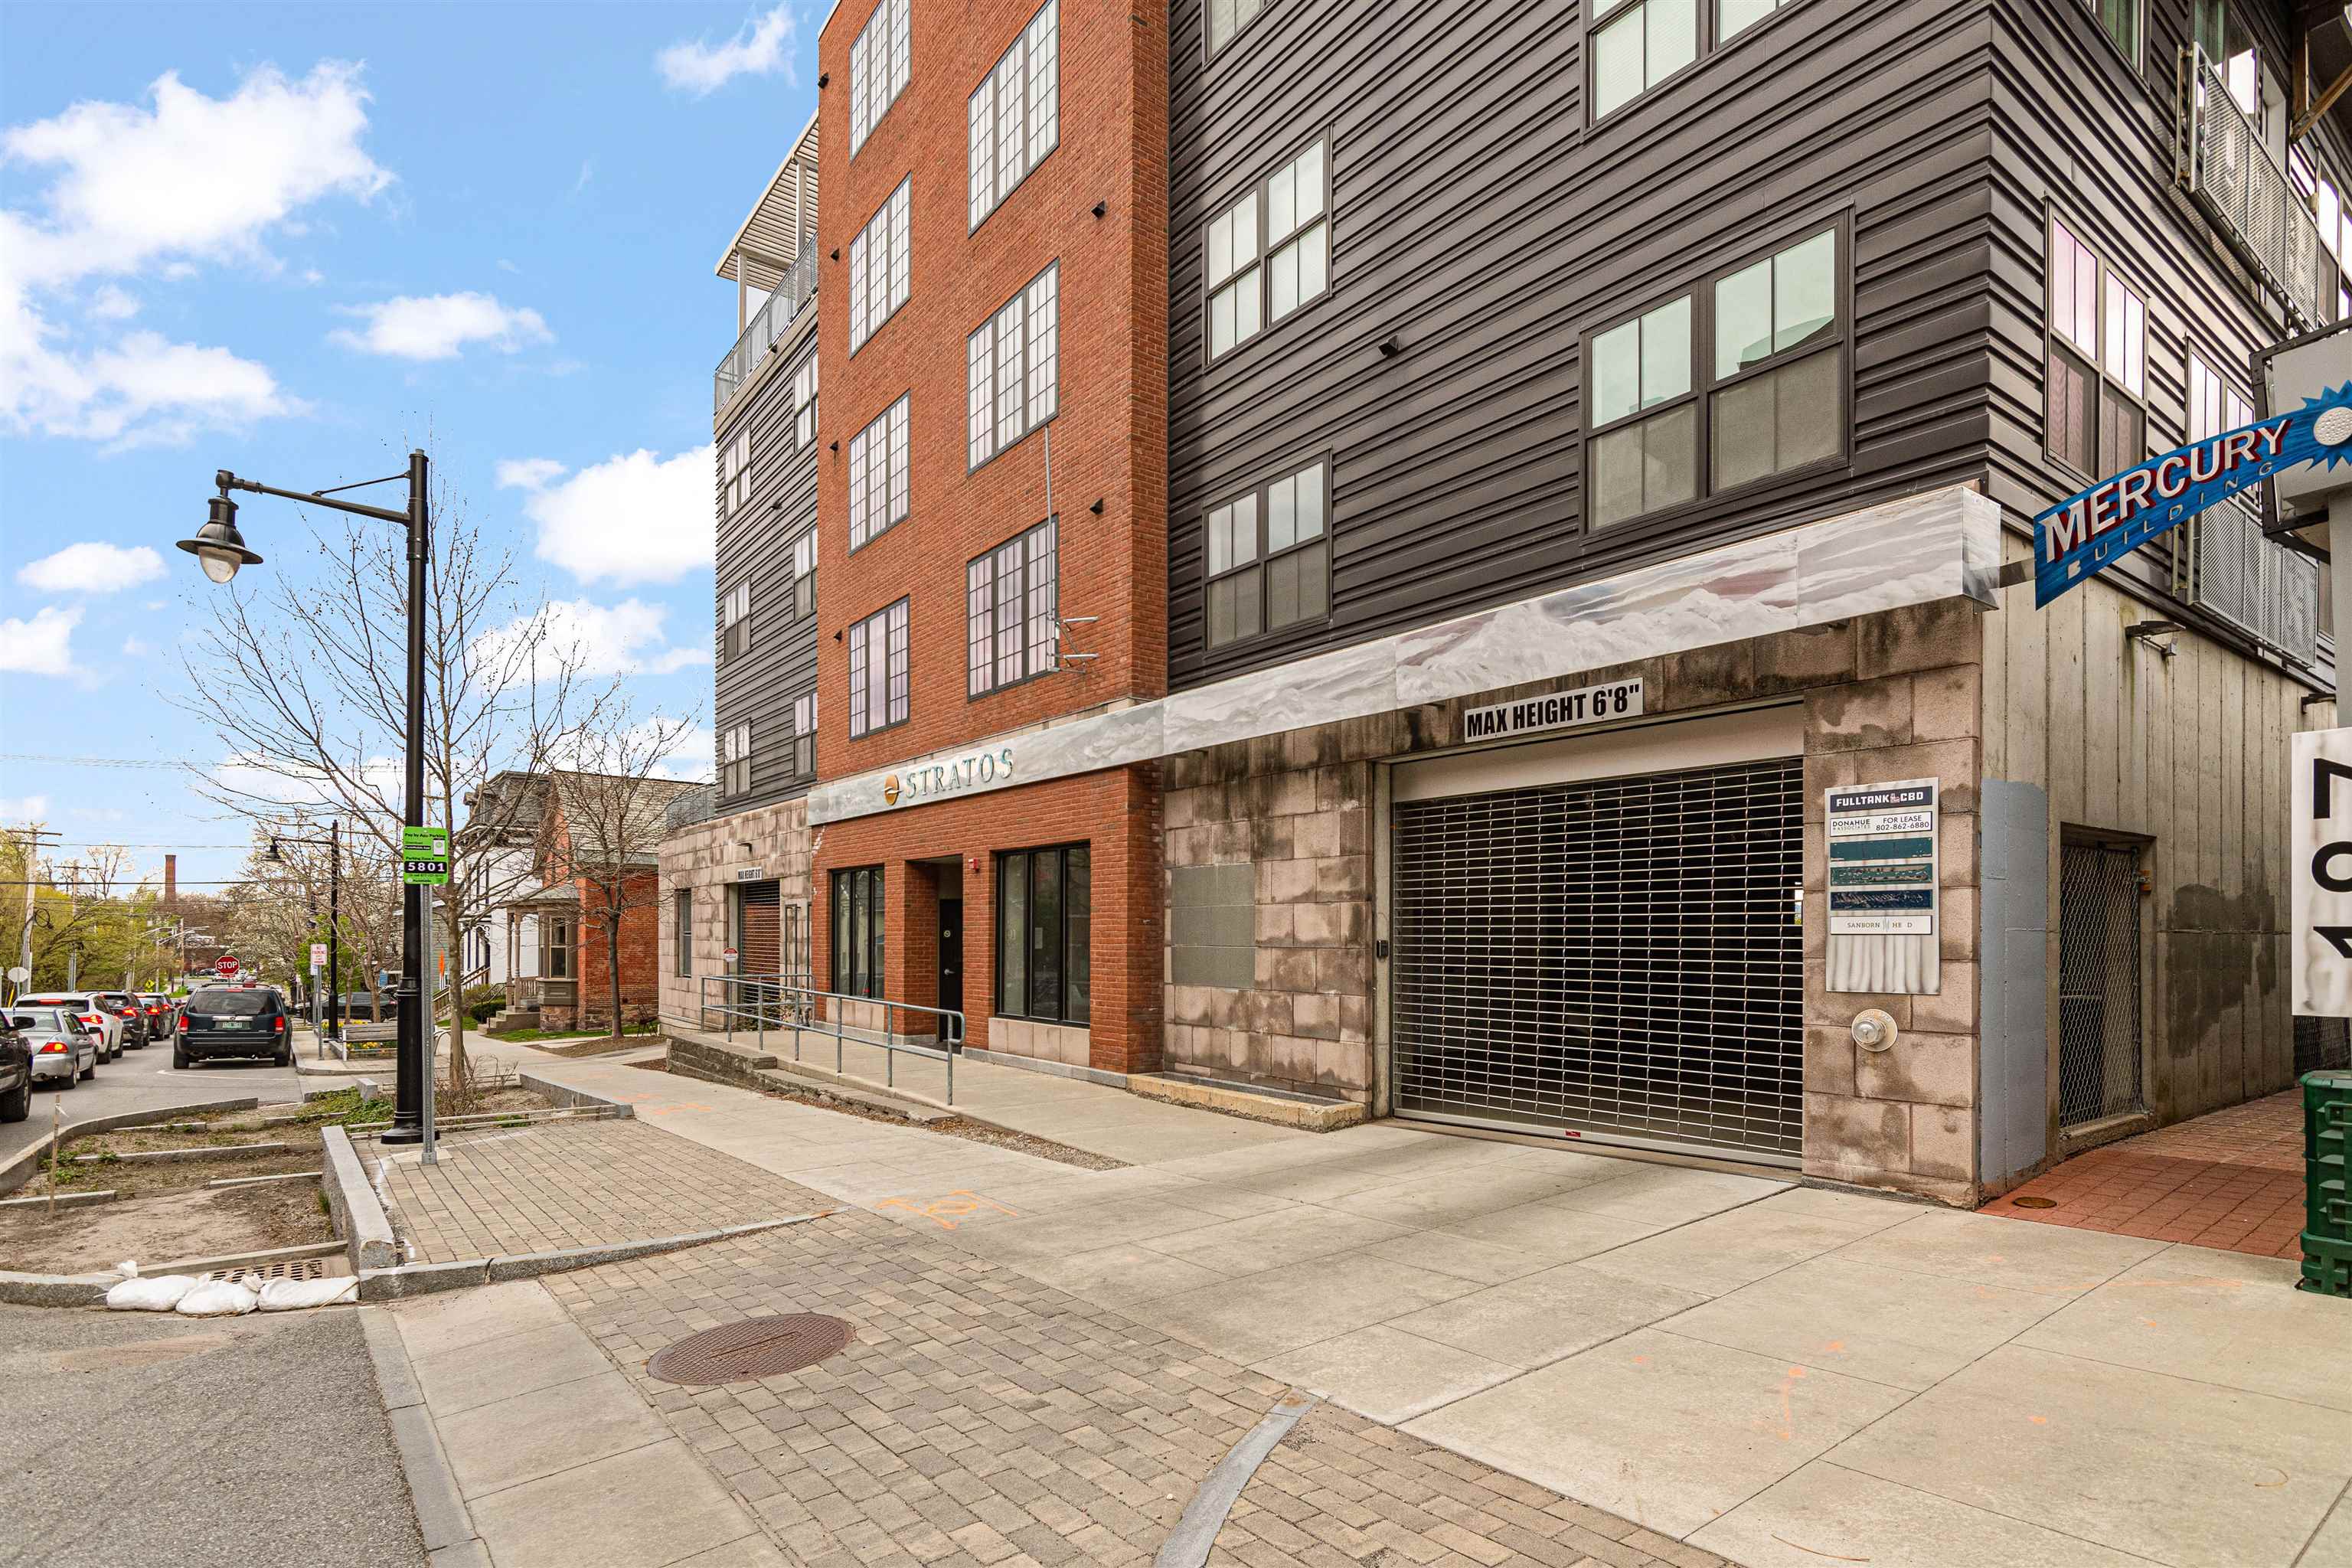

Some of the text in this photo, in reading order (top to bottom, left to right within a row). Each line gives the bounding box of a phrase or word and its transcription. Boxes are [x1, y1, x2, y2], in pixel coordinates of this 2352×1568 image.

[2039, 419, 2293, 563] MERCURY
[2066, 462, 2273, 580] BUILDING
[1467, 684, 1640, 737] MAX HEIGHT 6'8"
[906, 748, 1013, 799] STRATOS
[1836, 792, 1924, 807] FULLTANK CBD
[1832, 818, 1870, 827] DONAHUE
[1876, 822, 1929, 831] 802-862-6880
[1900, 815, 1922, 823] LEASE
[407, 862, 445, 872] 5801
